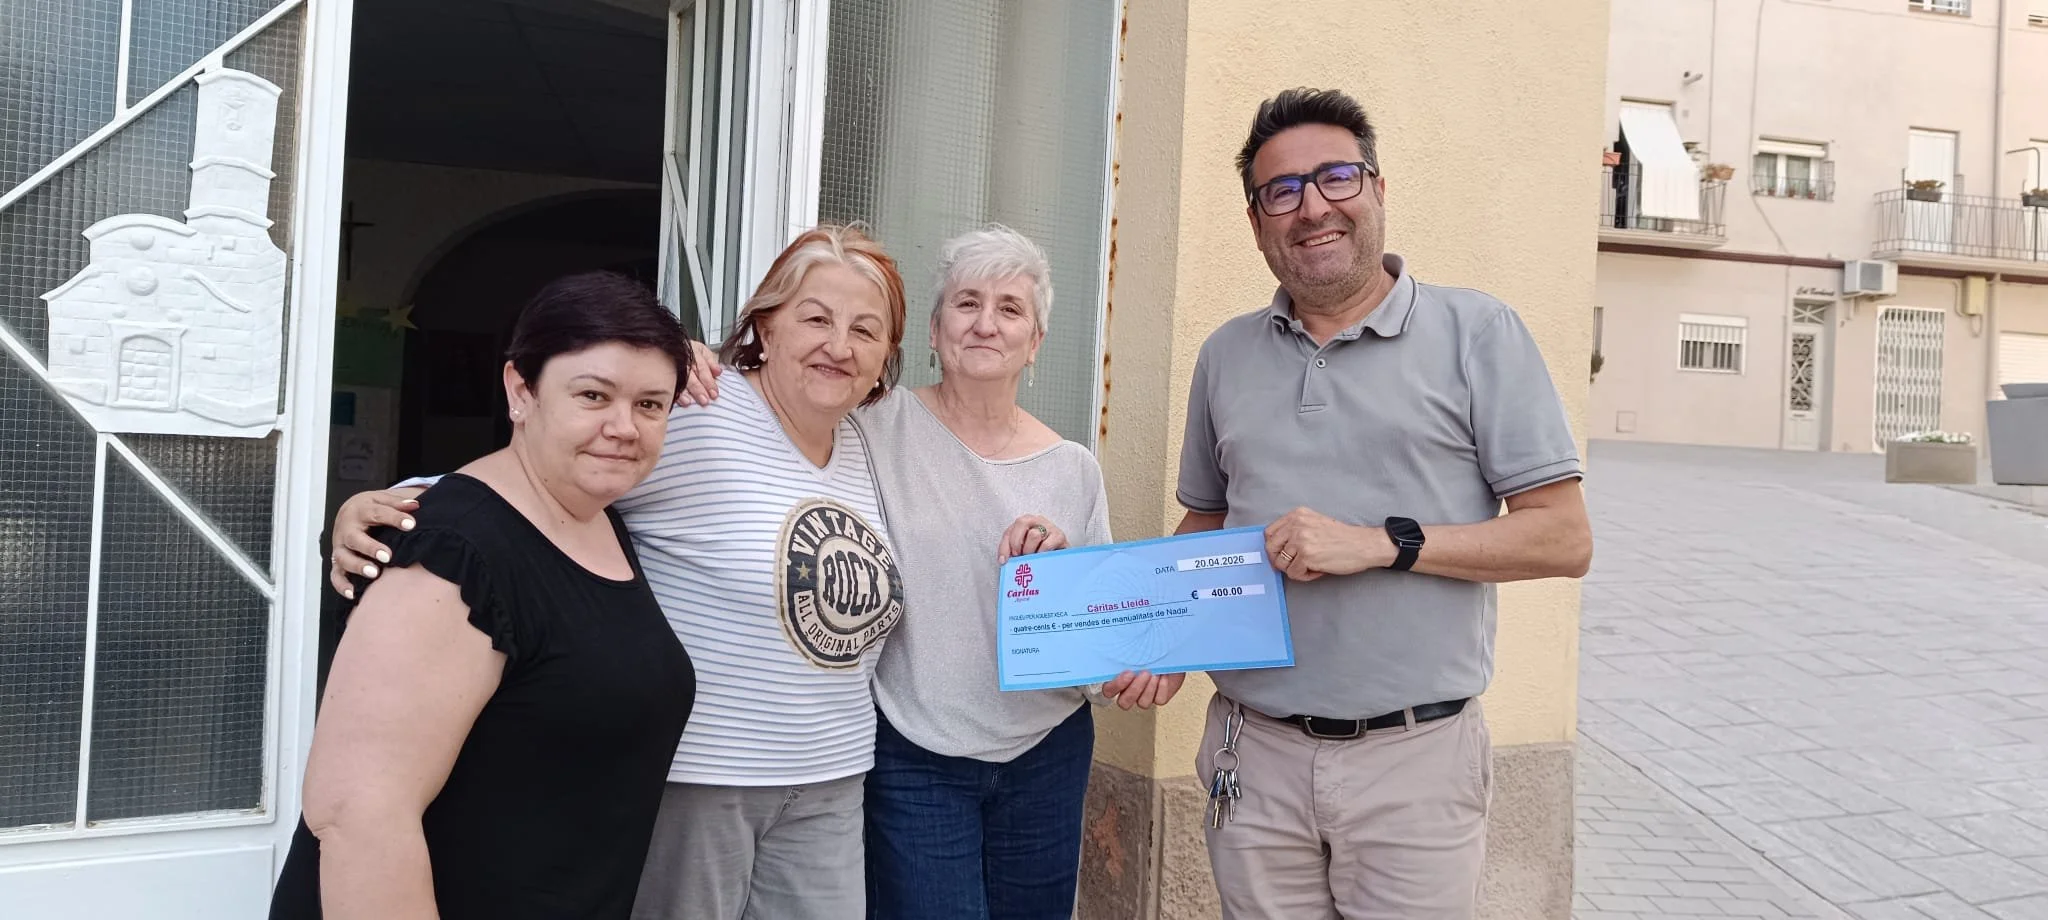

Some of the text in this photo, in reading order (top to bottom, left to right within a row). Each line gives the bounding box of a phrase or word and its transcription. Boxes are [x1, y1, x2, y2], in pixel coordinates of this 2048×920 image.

[792, 509, 893, 571] VINTAGE
[1155, 555, 1245, 575] DATA 20.04.2026
[822, 550, 881, 617] ROCK
[1191, 586, 1243, 600] € 400.00
[1121, 598, 1150, 609] Lleida
[799, 594, 899, 653] ALL ORIGINAL PARTS
[1051, 622, 1057, 630] €
[1062, 622, 1073, 630] per
[1074, 618, 1100, 628] vendes
[1101, 616, 1111, 625] de
[1112, 612, 1154, 624] manualitats
[1155, 609, 1165, 618] de
[1166, 606, 1189, 616] Nadal
